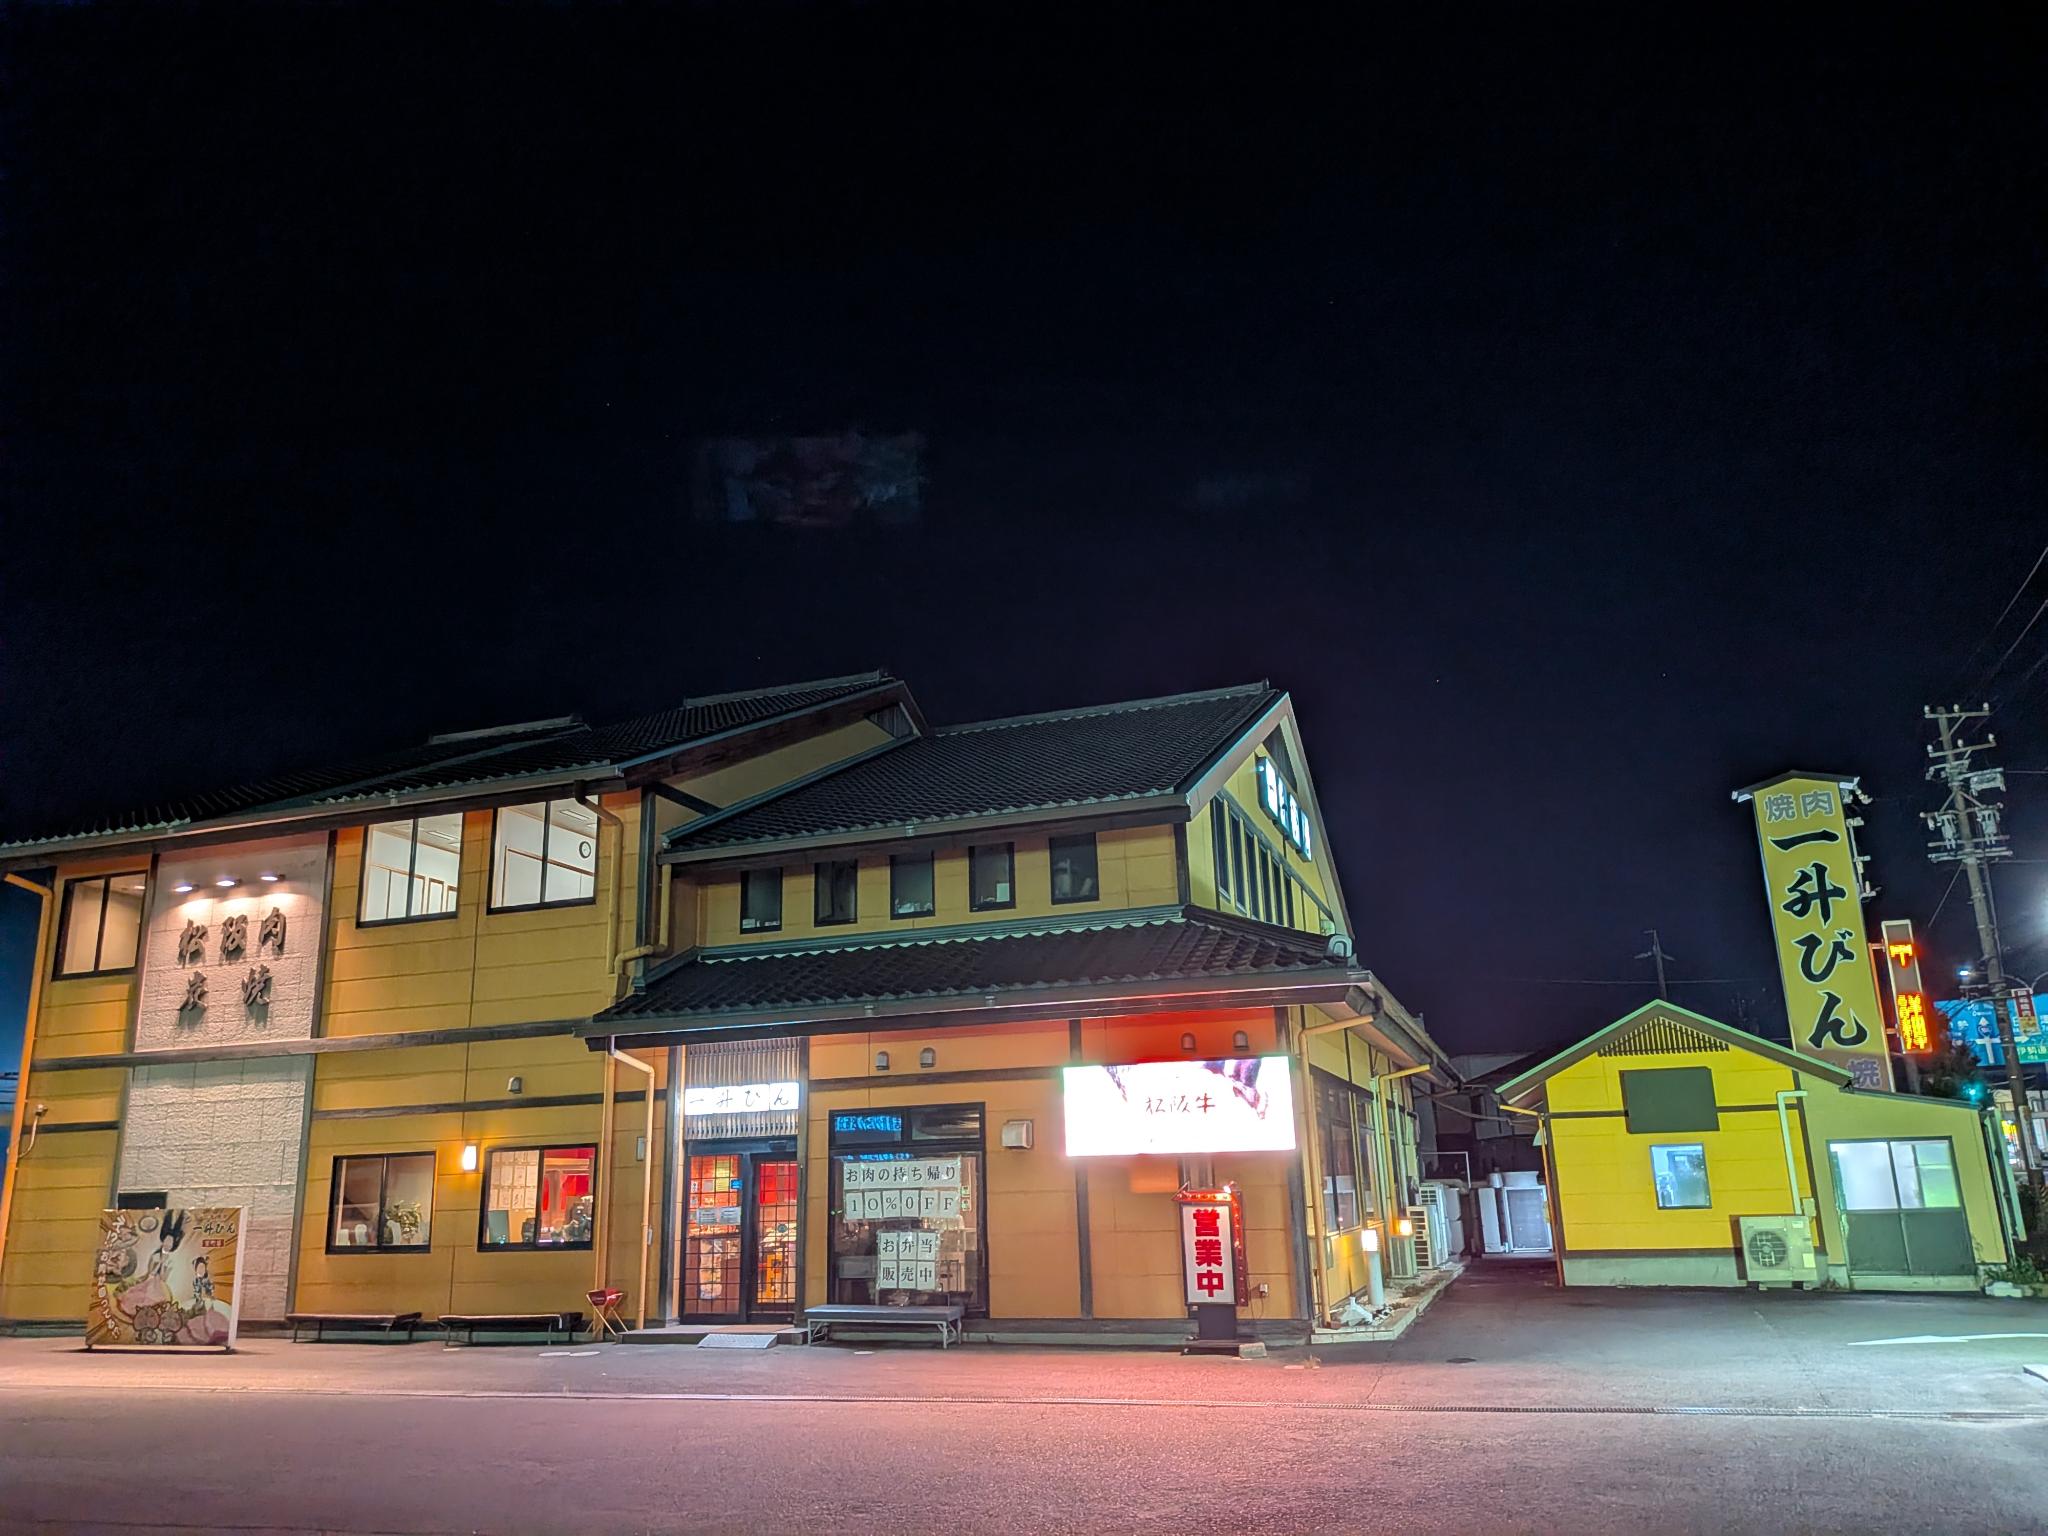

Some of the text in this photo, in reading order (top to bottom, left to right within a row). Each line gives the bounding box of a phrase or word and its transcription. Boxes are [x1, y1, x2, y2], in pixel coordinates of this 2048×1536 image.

[1765, 791, 1835, 823] 焼肉
[178, 906, 287, 957] 松阪肉
[1768, 828, 1868, 1049] 一升びん
[689, 1088, 790, 1107] 一升びん
[1145, 1092, 1216, 1114] 松阪牛
[845, 1165, 956, 1183] お肉の持ち帰り
[882, 1237, 933, 1254] お弁当
[1192, 1208, 1224, 1298] 営業中
[882, 1266, 932, 1283] 販売中
